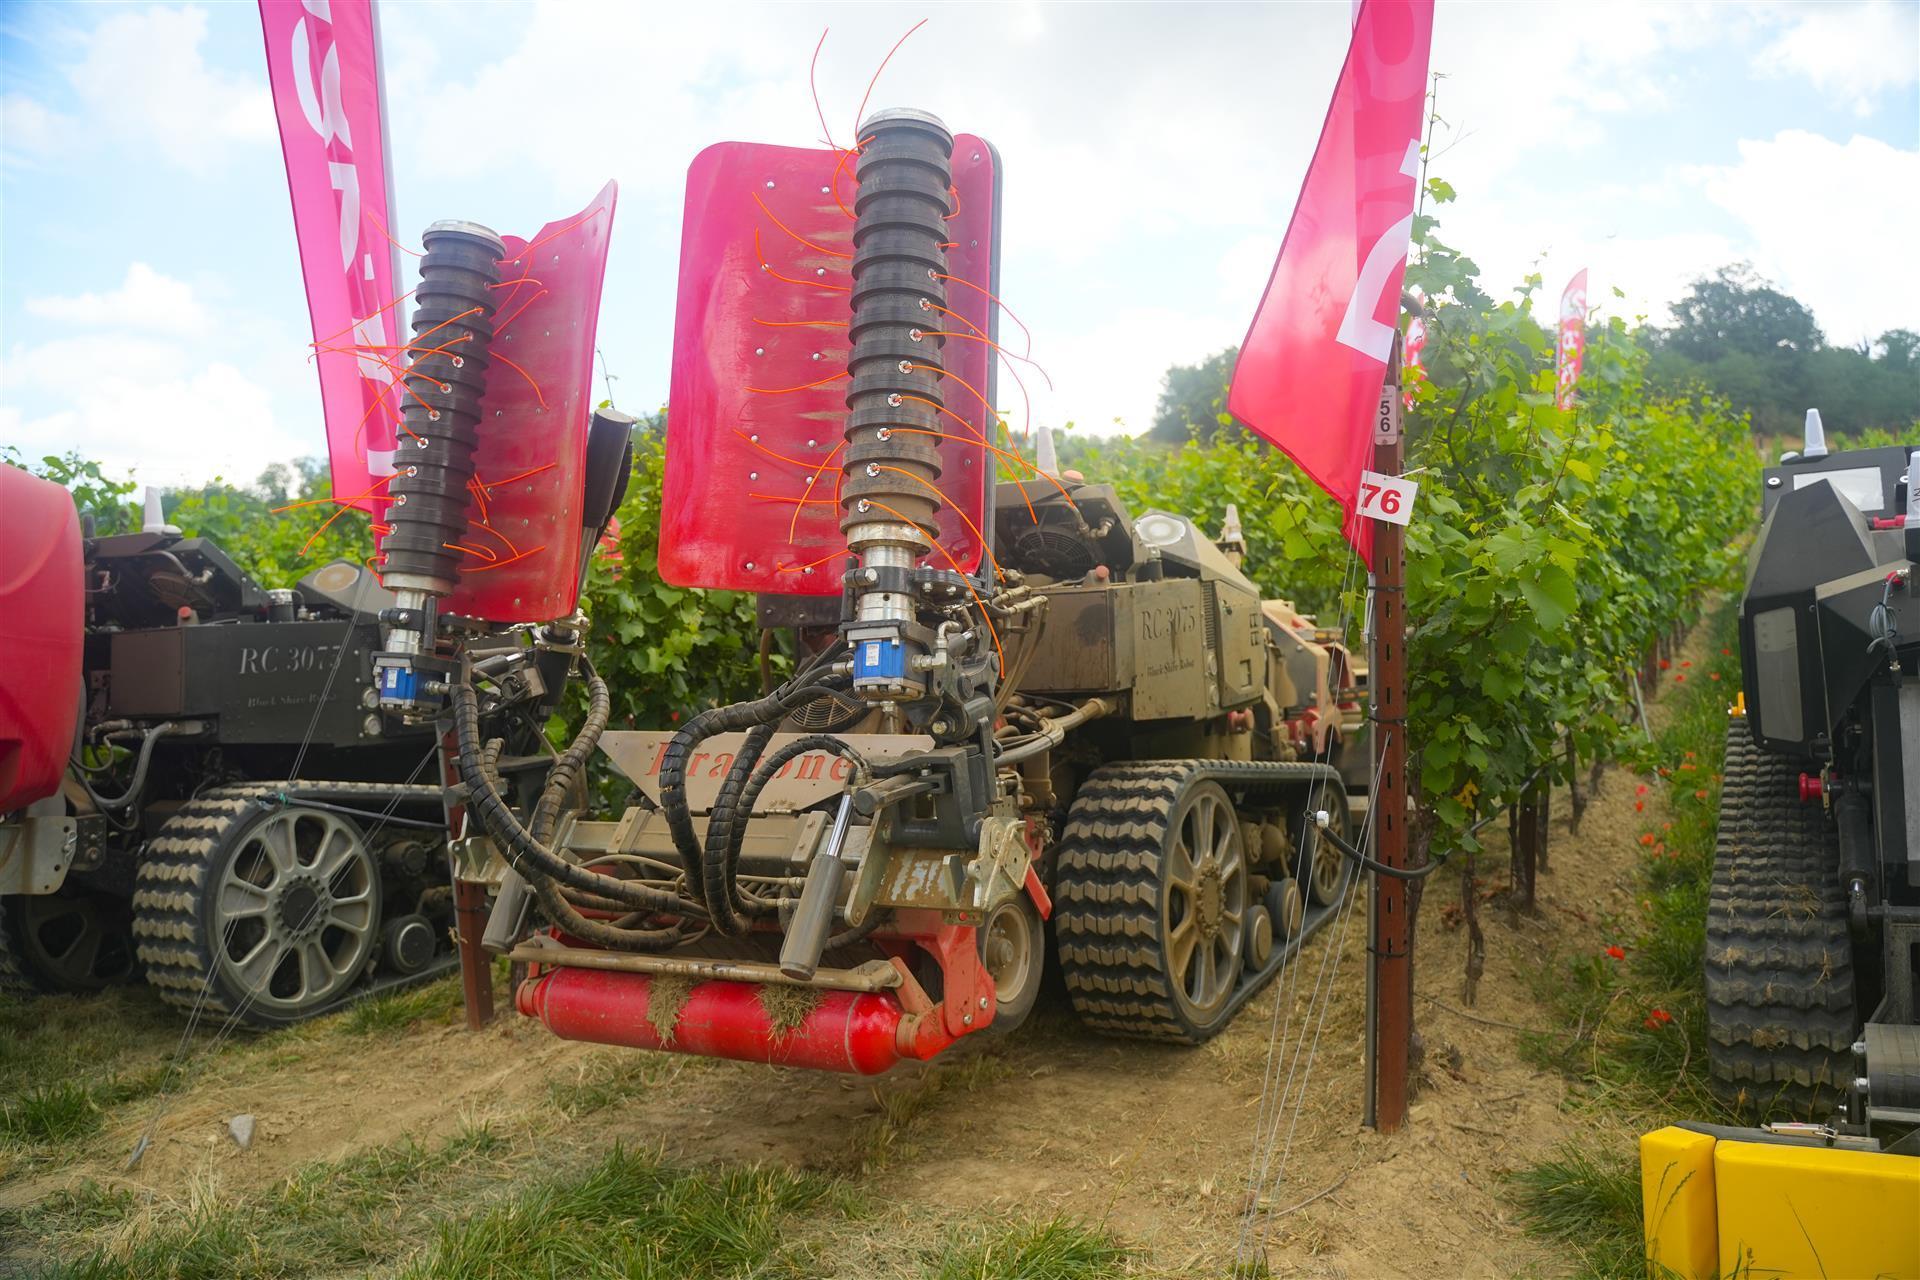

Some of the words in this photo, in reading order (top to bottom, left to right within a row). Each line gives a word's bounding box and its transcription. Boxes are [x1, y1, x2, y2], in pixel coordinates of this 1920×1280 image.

[1361, 483, 1402, 515] 76
[1141, 607, 1162, 640] RC
[1166, 605, 1195, 635] 3075
[239, 646, 279, 674] RC
